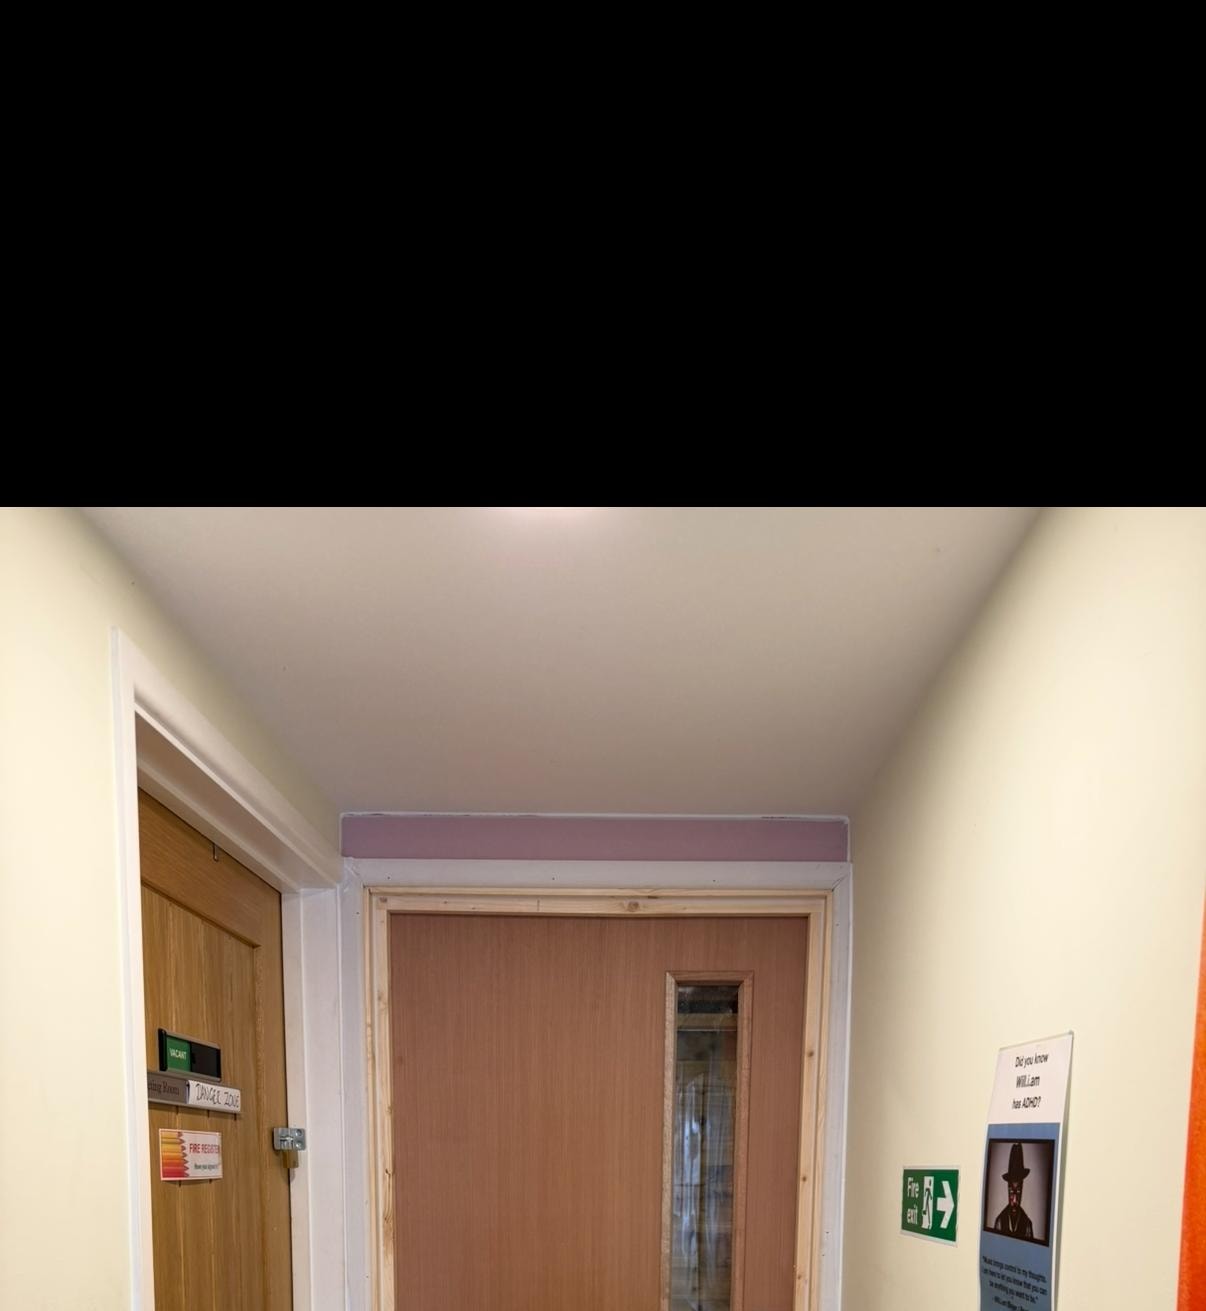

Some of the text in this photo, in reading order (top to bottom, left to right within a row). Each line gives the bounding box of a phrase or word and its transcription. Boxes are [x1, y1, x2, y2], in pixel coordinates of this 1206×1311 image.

[169, 1047, 187, 1060] VACANT
[1015, 1052, 1049, 1068] Did you know
[162, 1081, 180, 1097] Room
[224, 1091, 239, 1108] ZONE
[1012, 1095, 1041, 1109] has ADHD?
[189, 1143, 201, 1153] FIRE
[907, 1176, 919, 1198] Fire
[906, 1204, 918, 1224] exit
